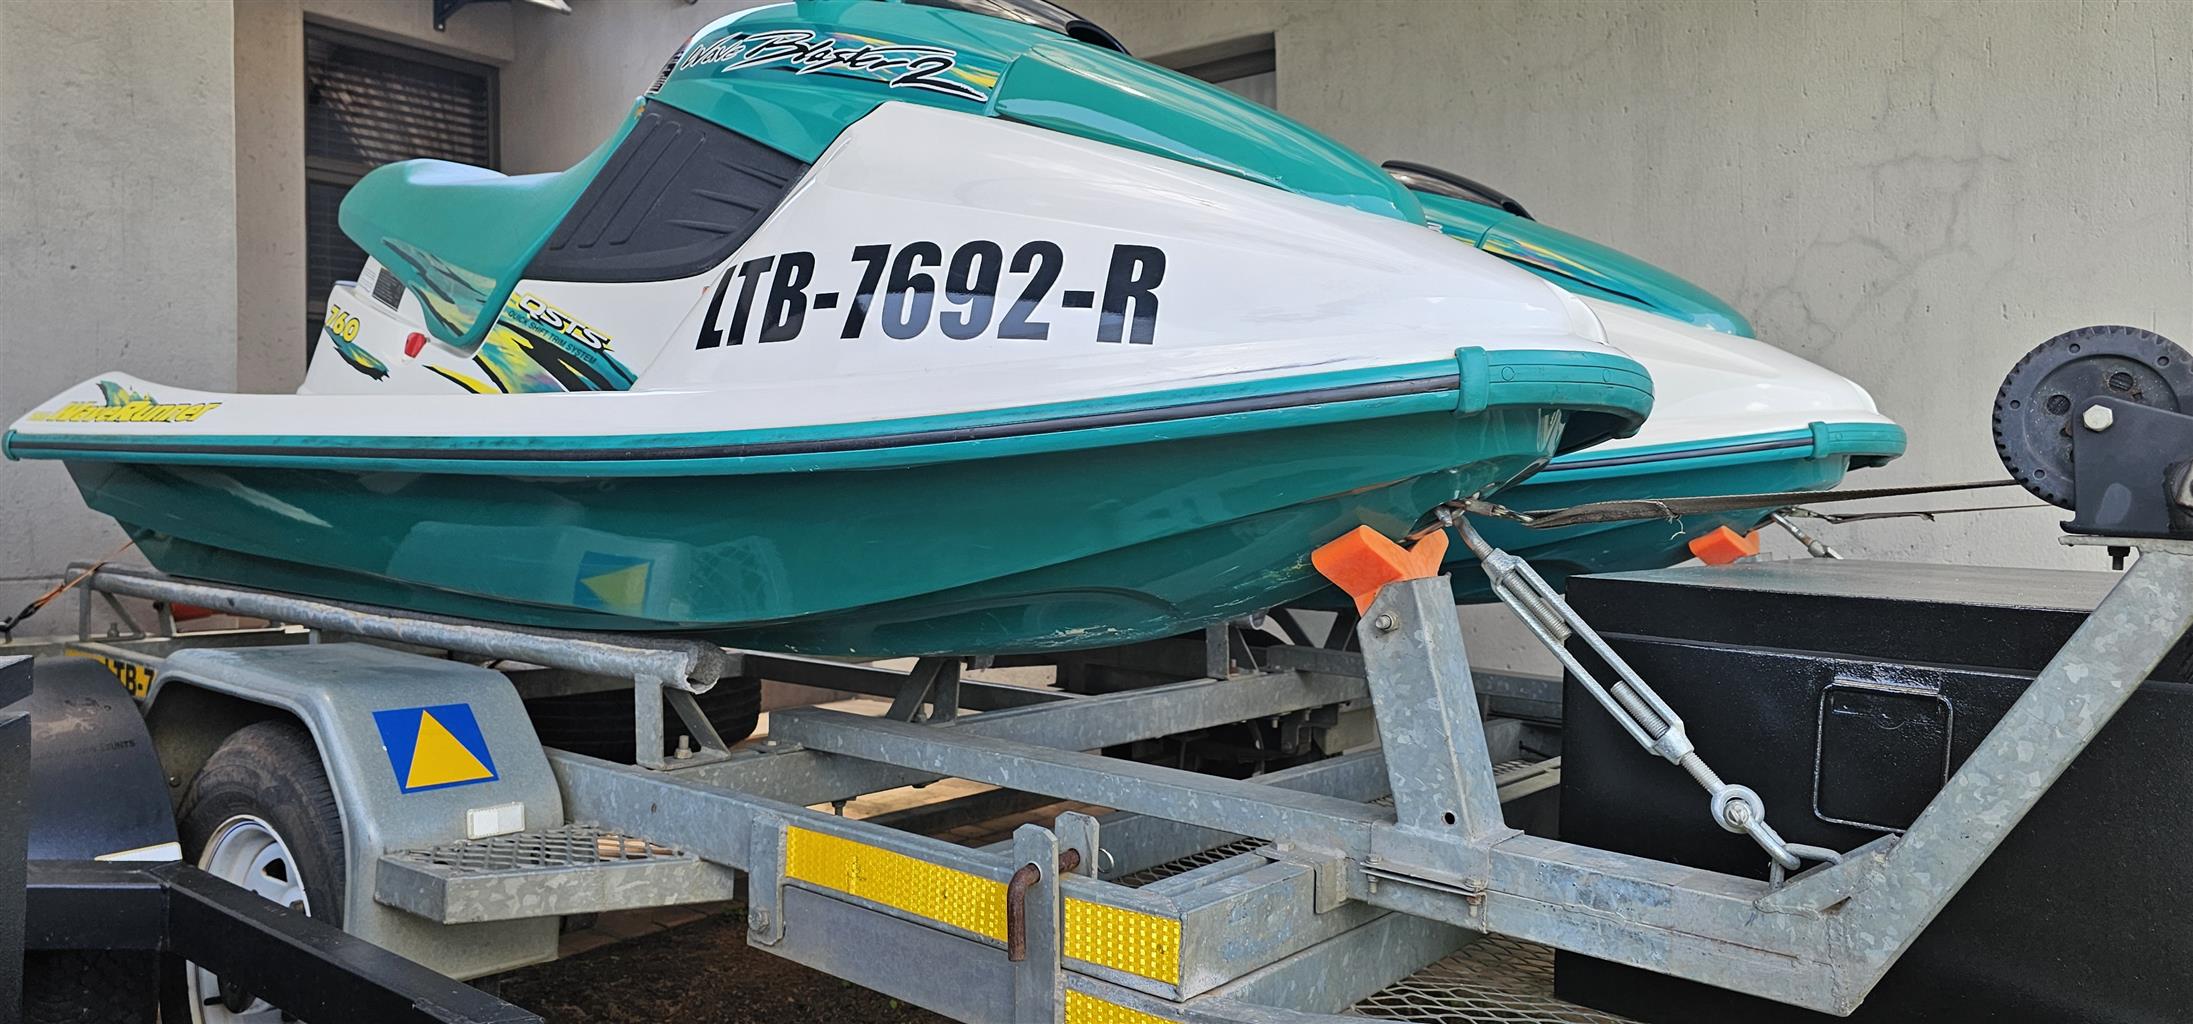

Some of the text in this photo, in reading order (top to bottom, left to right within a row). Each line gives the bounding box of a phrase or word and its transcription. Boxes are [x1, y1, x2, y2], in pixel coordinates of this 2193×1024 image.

[721, 30, 957, 75] Blaster
[890, 56, 989, 103] 2
[325, 304, 360, 343] 760
[695, 240, 1167, 351] LTB-7692-R
[508, 310, 598, 364] QUICK SHIFT TRIM SYSTEM
